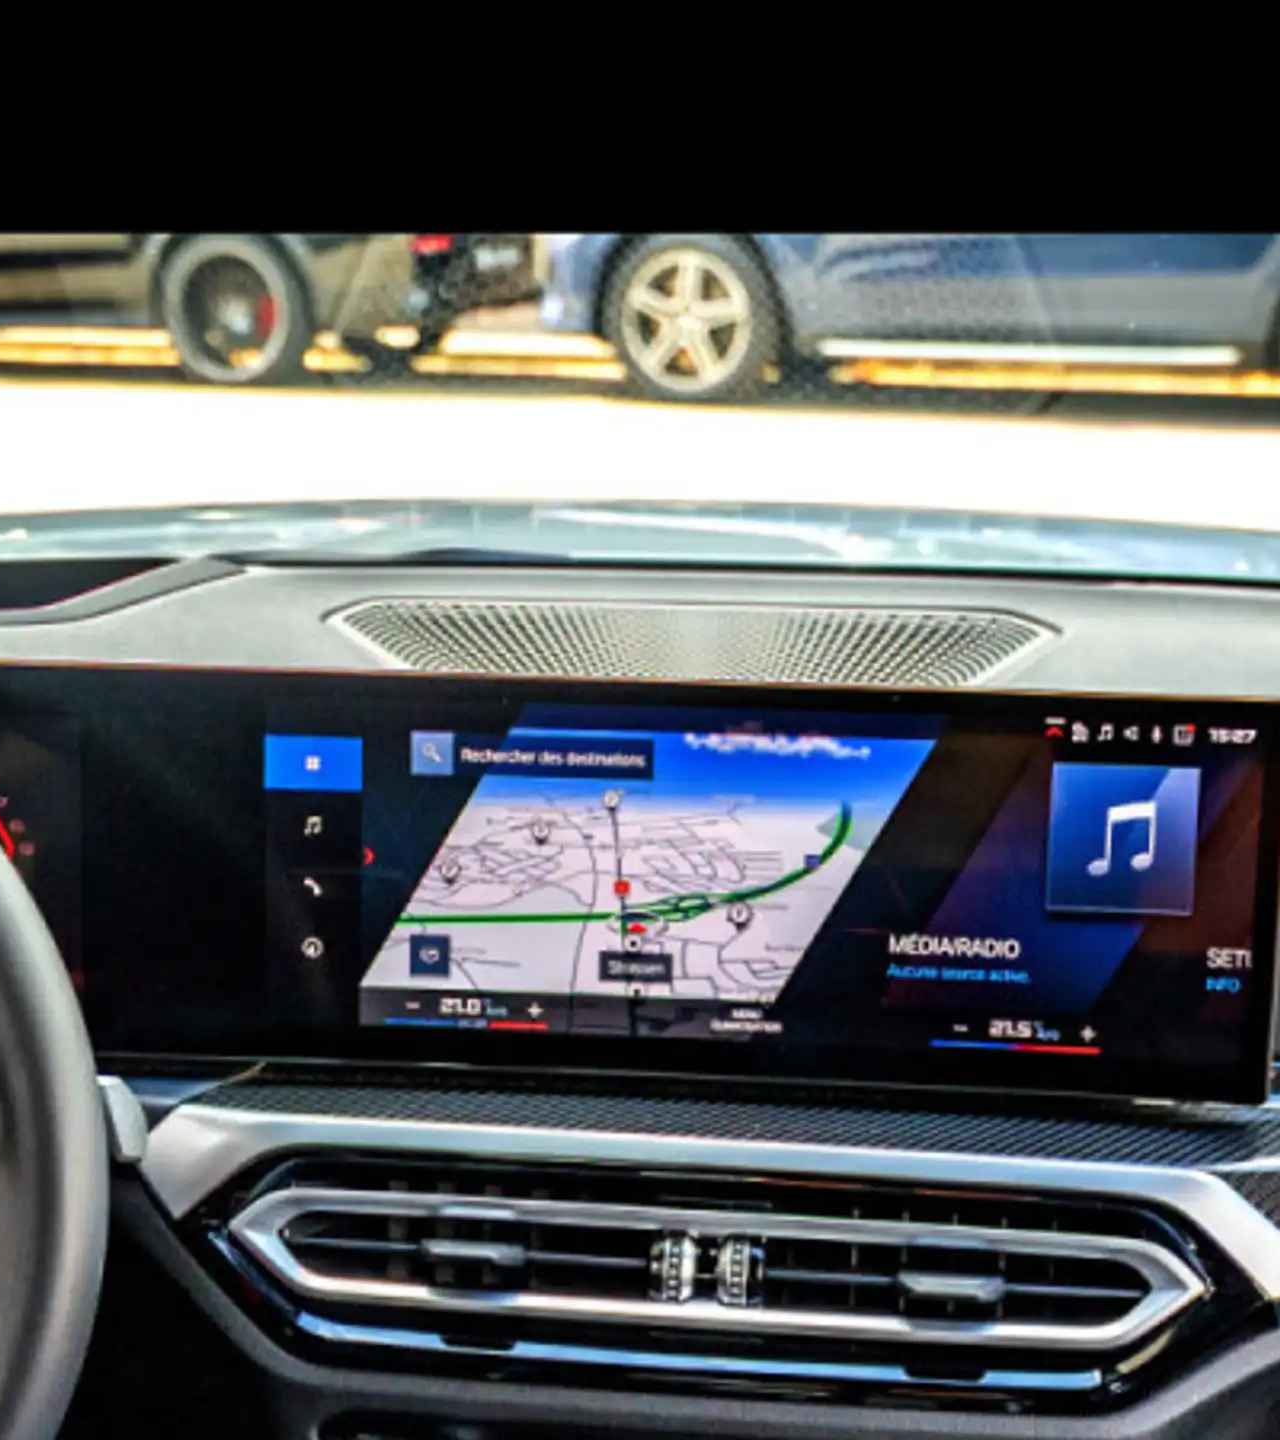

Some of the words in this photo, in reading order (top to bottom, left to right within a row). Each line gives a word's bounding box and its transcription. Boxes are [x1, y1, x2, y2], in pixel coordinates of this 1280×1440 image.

[461, 748, 535, 765] Rechercher
[538, 749, 564, 766] des
[567, 751, 647, 769] destinations
[887, 962, 938, 980] Aucune
